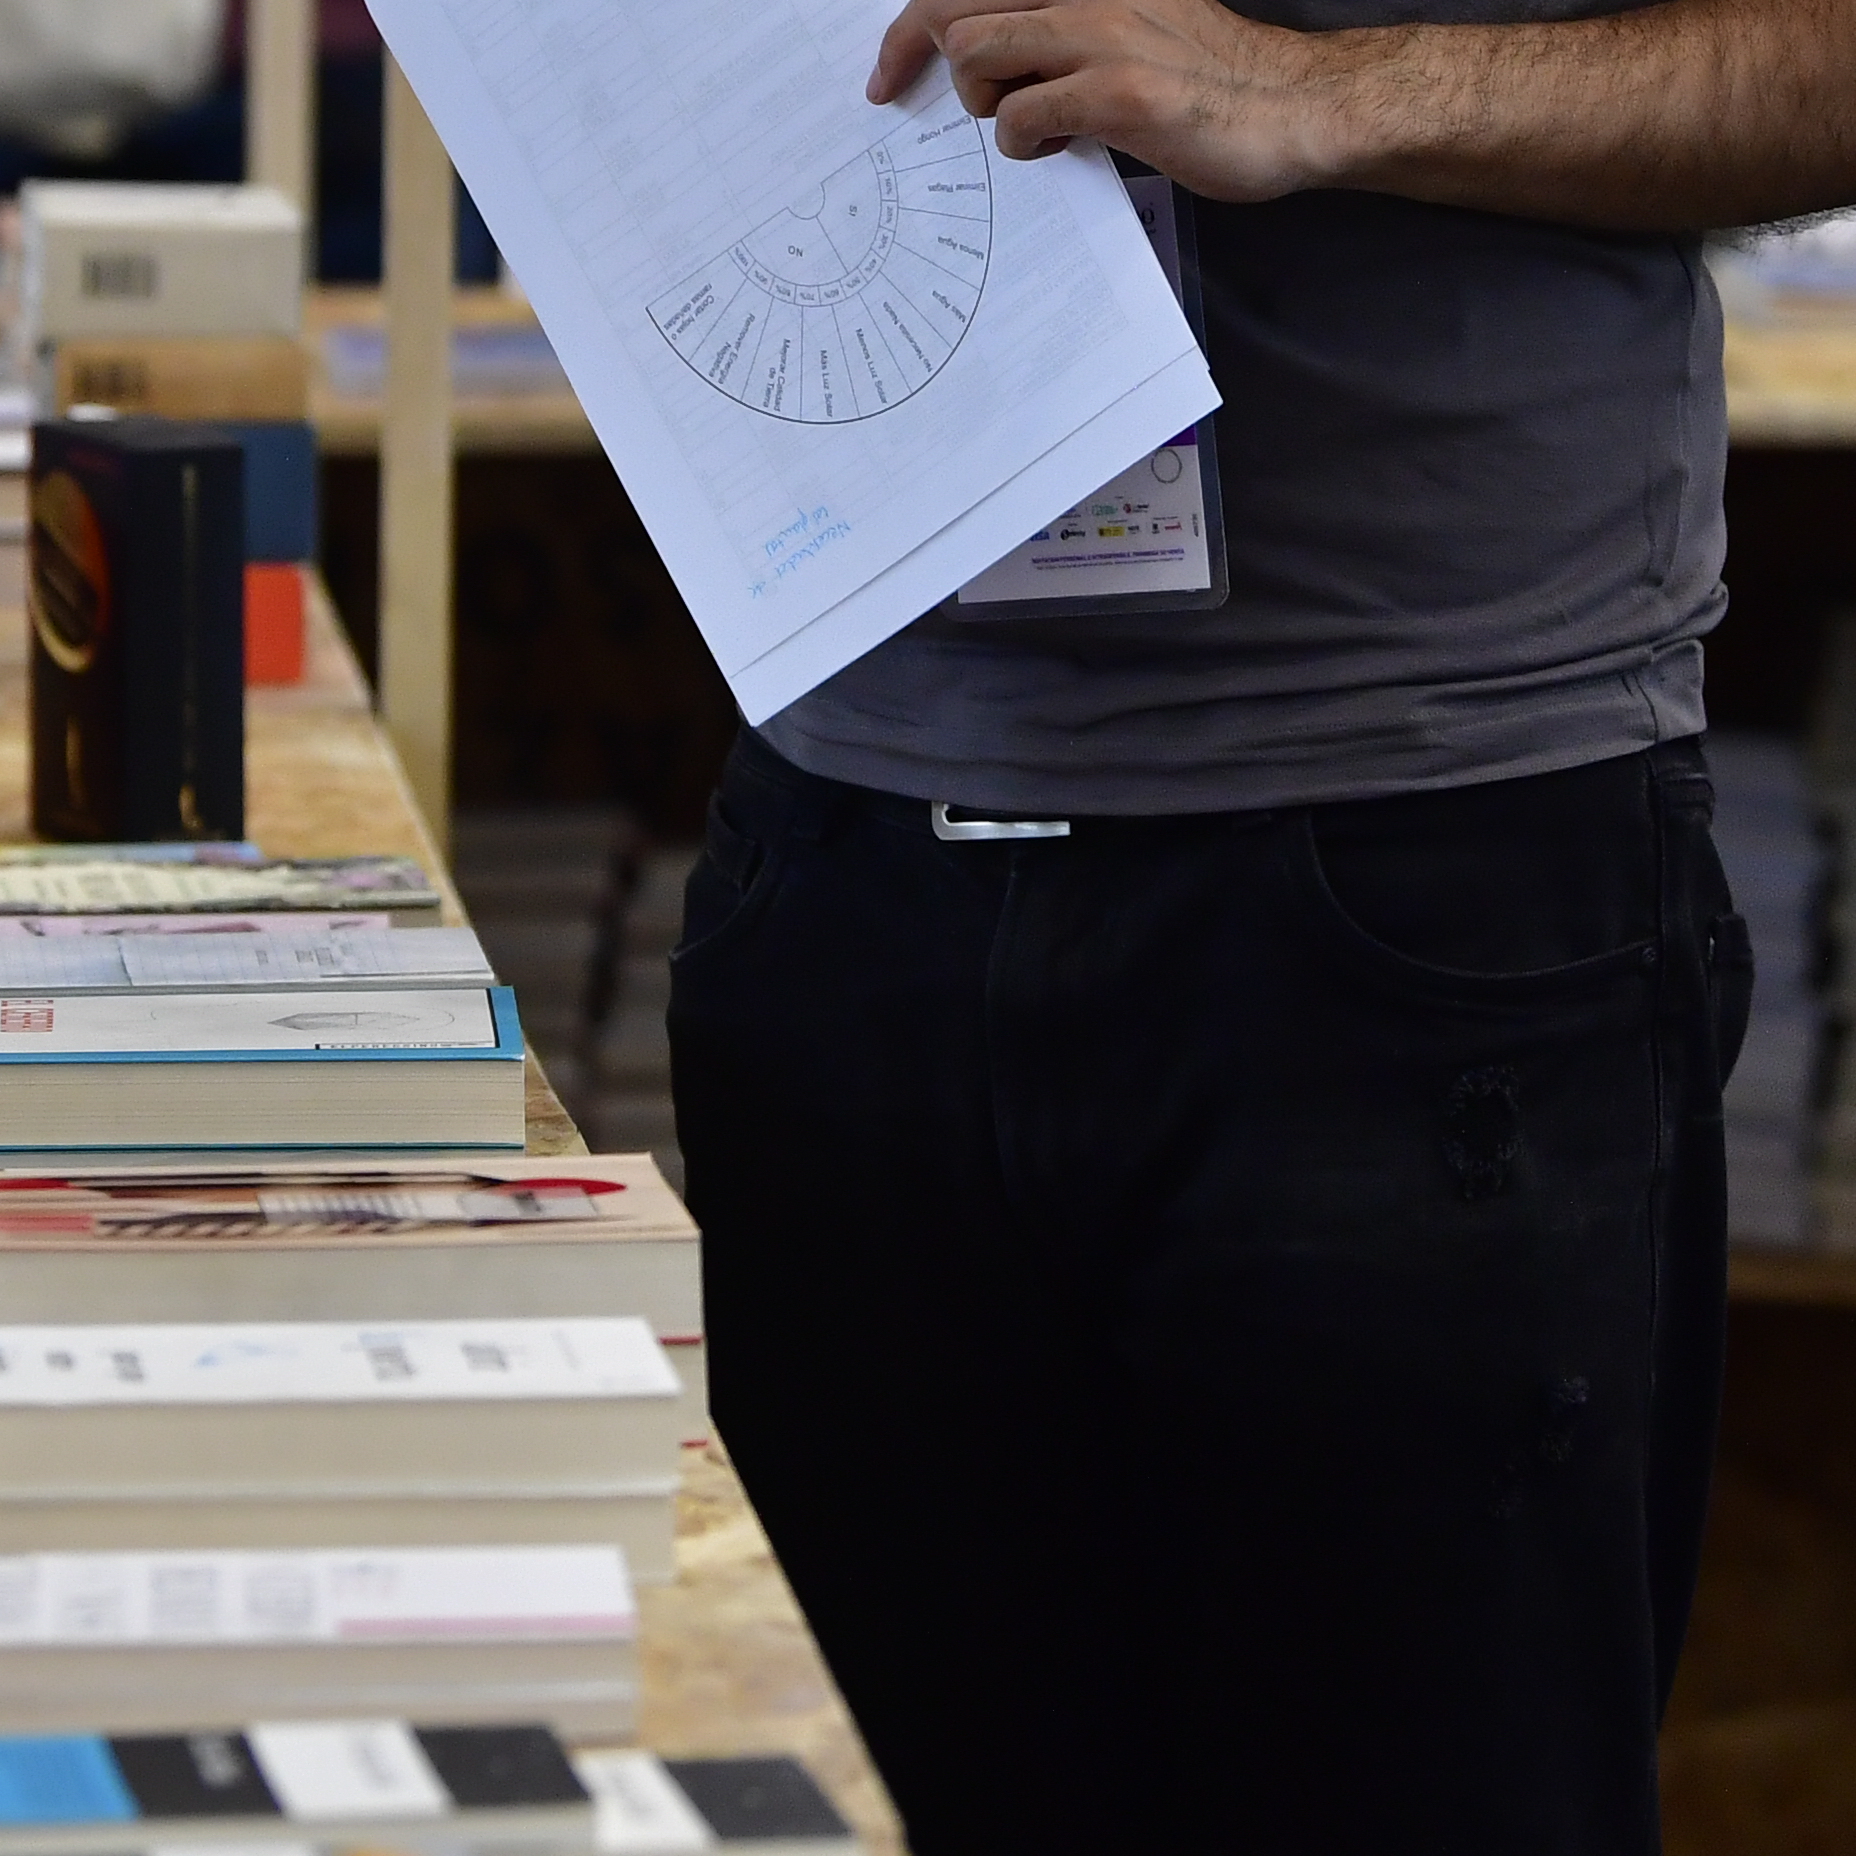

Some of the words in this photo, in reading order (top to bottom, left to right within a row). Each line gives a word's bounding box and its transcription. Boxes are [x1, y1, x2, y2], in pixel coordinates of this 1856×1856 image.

[917, 128, 941, 145] Hongo
[927, 182, 954, 193] Plagas
[955, 182, 986, 192] Eliminar
[787, 245, 803, 257] NO
[937, 236, 958, 250] Agua
[959, 244, 985, 261] Menos
[690, 283, 713, 305] ramas
[800, 292, 815, 301] 70%
[932, 290, 951, 309] Agua
[694, 294, 715, 318] Cortar
[883, 301, 899, 325] Nada
[676, 314, 695, 334] hojas
[735, 312, 756, 352] Remover
[708, 341, 732, 378] Negativa
[780, 338, 791, 374] Mejorar
[855, 328, 871, 360] Menos
[867, 361, 879, 379] Luz
[875, 380, 888, 404] Solar
[768, 367, 776, 380] de
[822, 372, 831, 390] Luz
[762, 382, 775, 408] Tierra
[774, 375, 785, 413] Calidad
[824, 393, 833, 418] Solar
